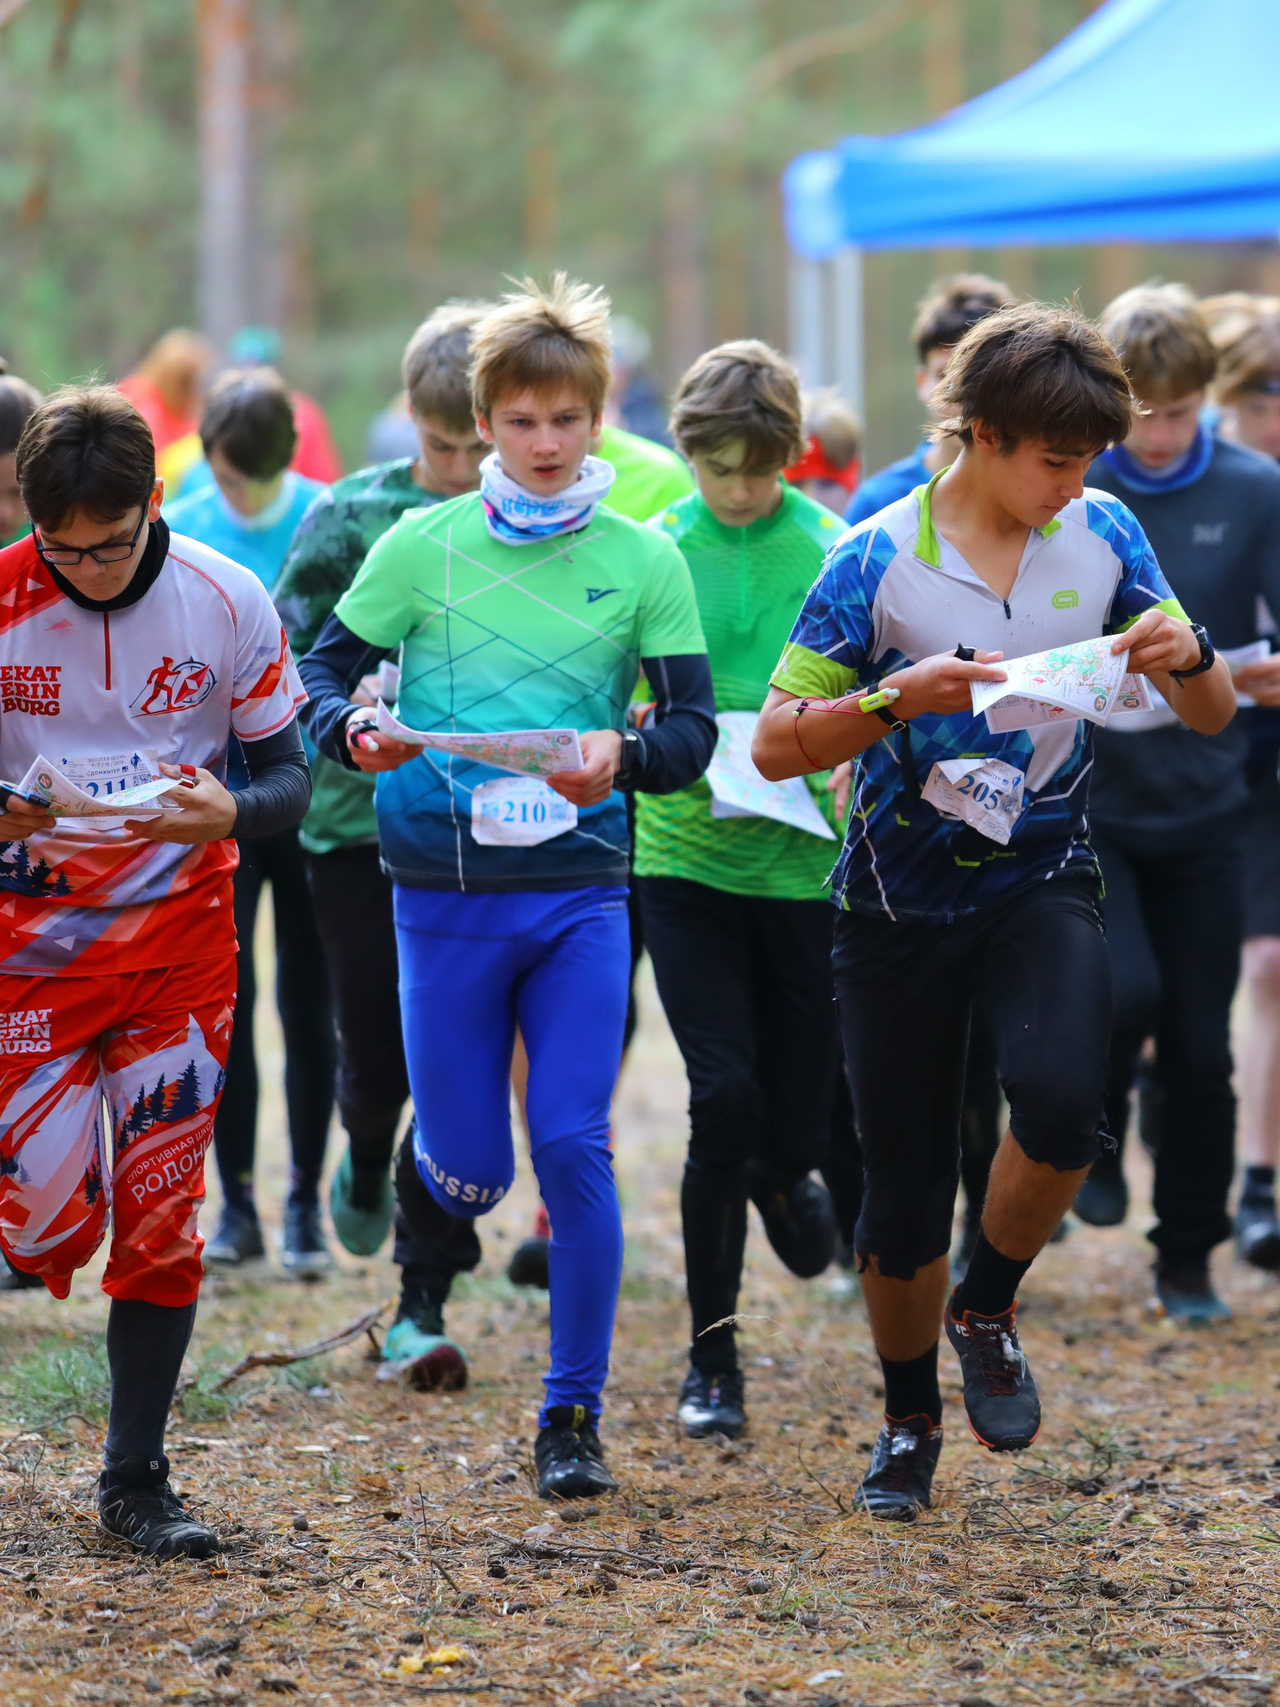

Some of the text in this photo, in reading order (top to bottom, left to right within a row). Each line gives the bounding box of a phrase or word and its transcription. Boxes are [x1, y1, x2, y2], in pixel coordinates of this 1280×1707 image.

[0, 665, 62, 682] EKAT
[0, 681, 61, 699] ERIN
[2, 697, 60, 716] BURG
[86, 778, 125, 798] 211
[956, 774, 1004, 811] 205
[502, 800, 546, 824] 210
[127, 1136, 195, 1184] СПОРТИВНАЯ
[422, 1152, 505, 1203] RUSSIA
